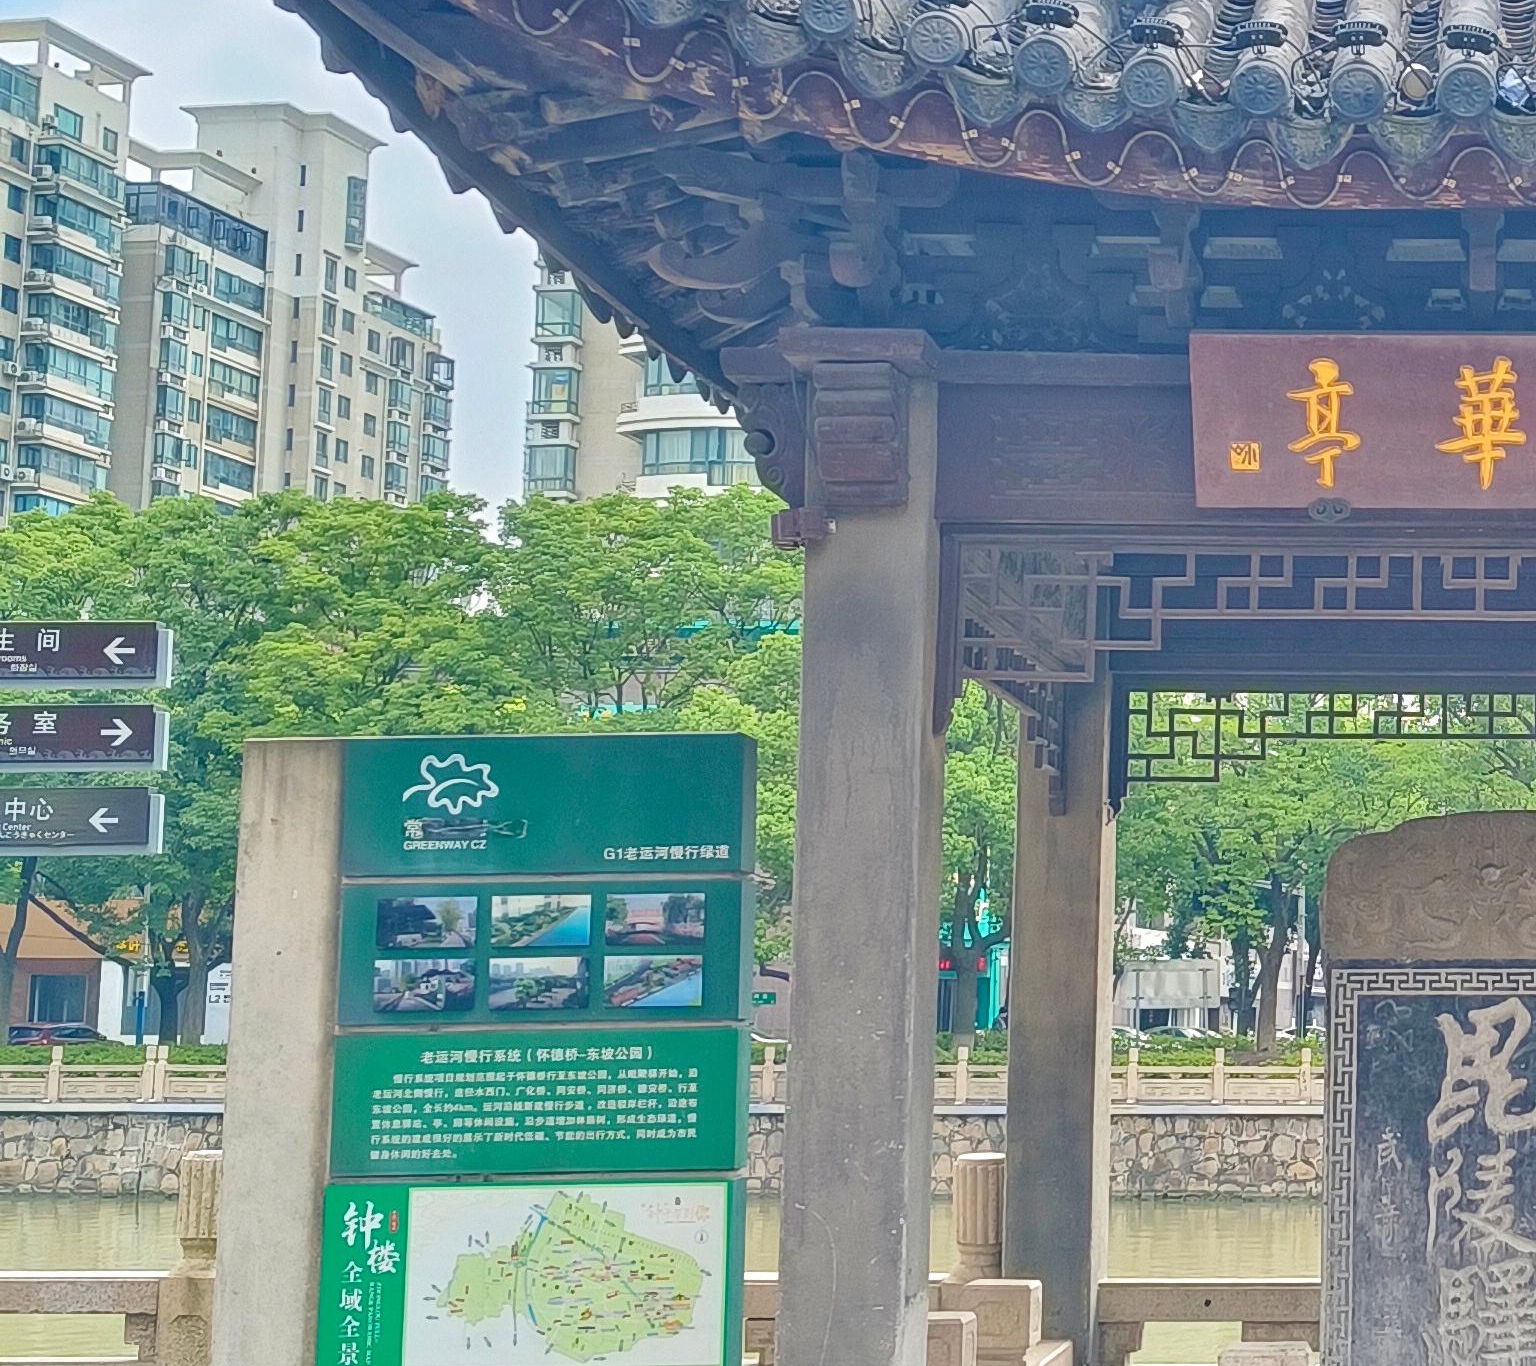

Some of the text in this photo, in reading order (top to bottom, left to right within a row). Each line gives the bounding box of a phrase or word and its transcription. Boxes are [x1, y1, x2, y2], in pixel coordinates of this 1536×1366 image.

[0, 655, 27, 663] ooms
[5, 797, 54, 821] 中心
[2, 823, 32, 831] Center
[403, 840, 487, 850] GREENWAY CZ
[603, 845, 730, 861] G1老运河慢行绿道
[341, 1200, 401, 1275] 钟楼
